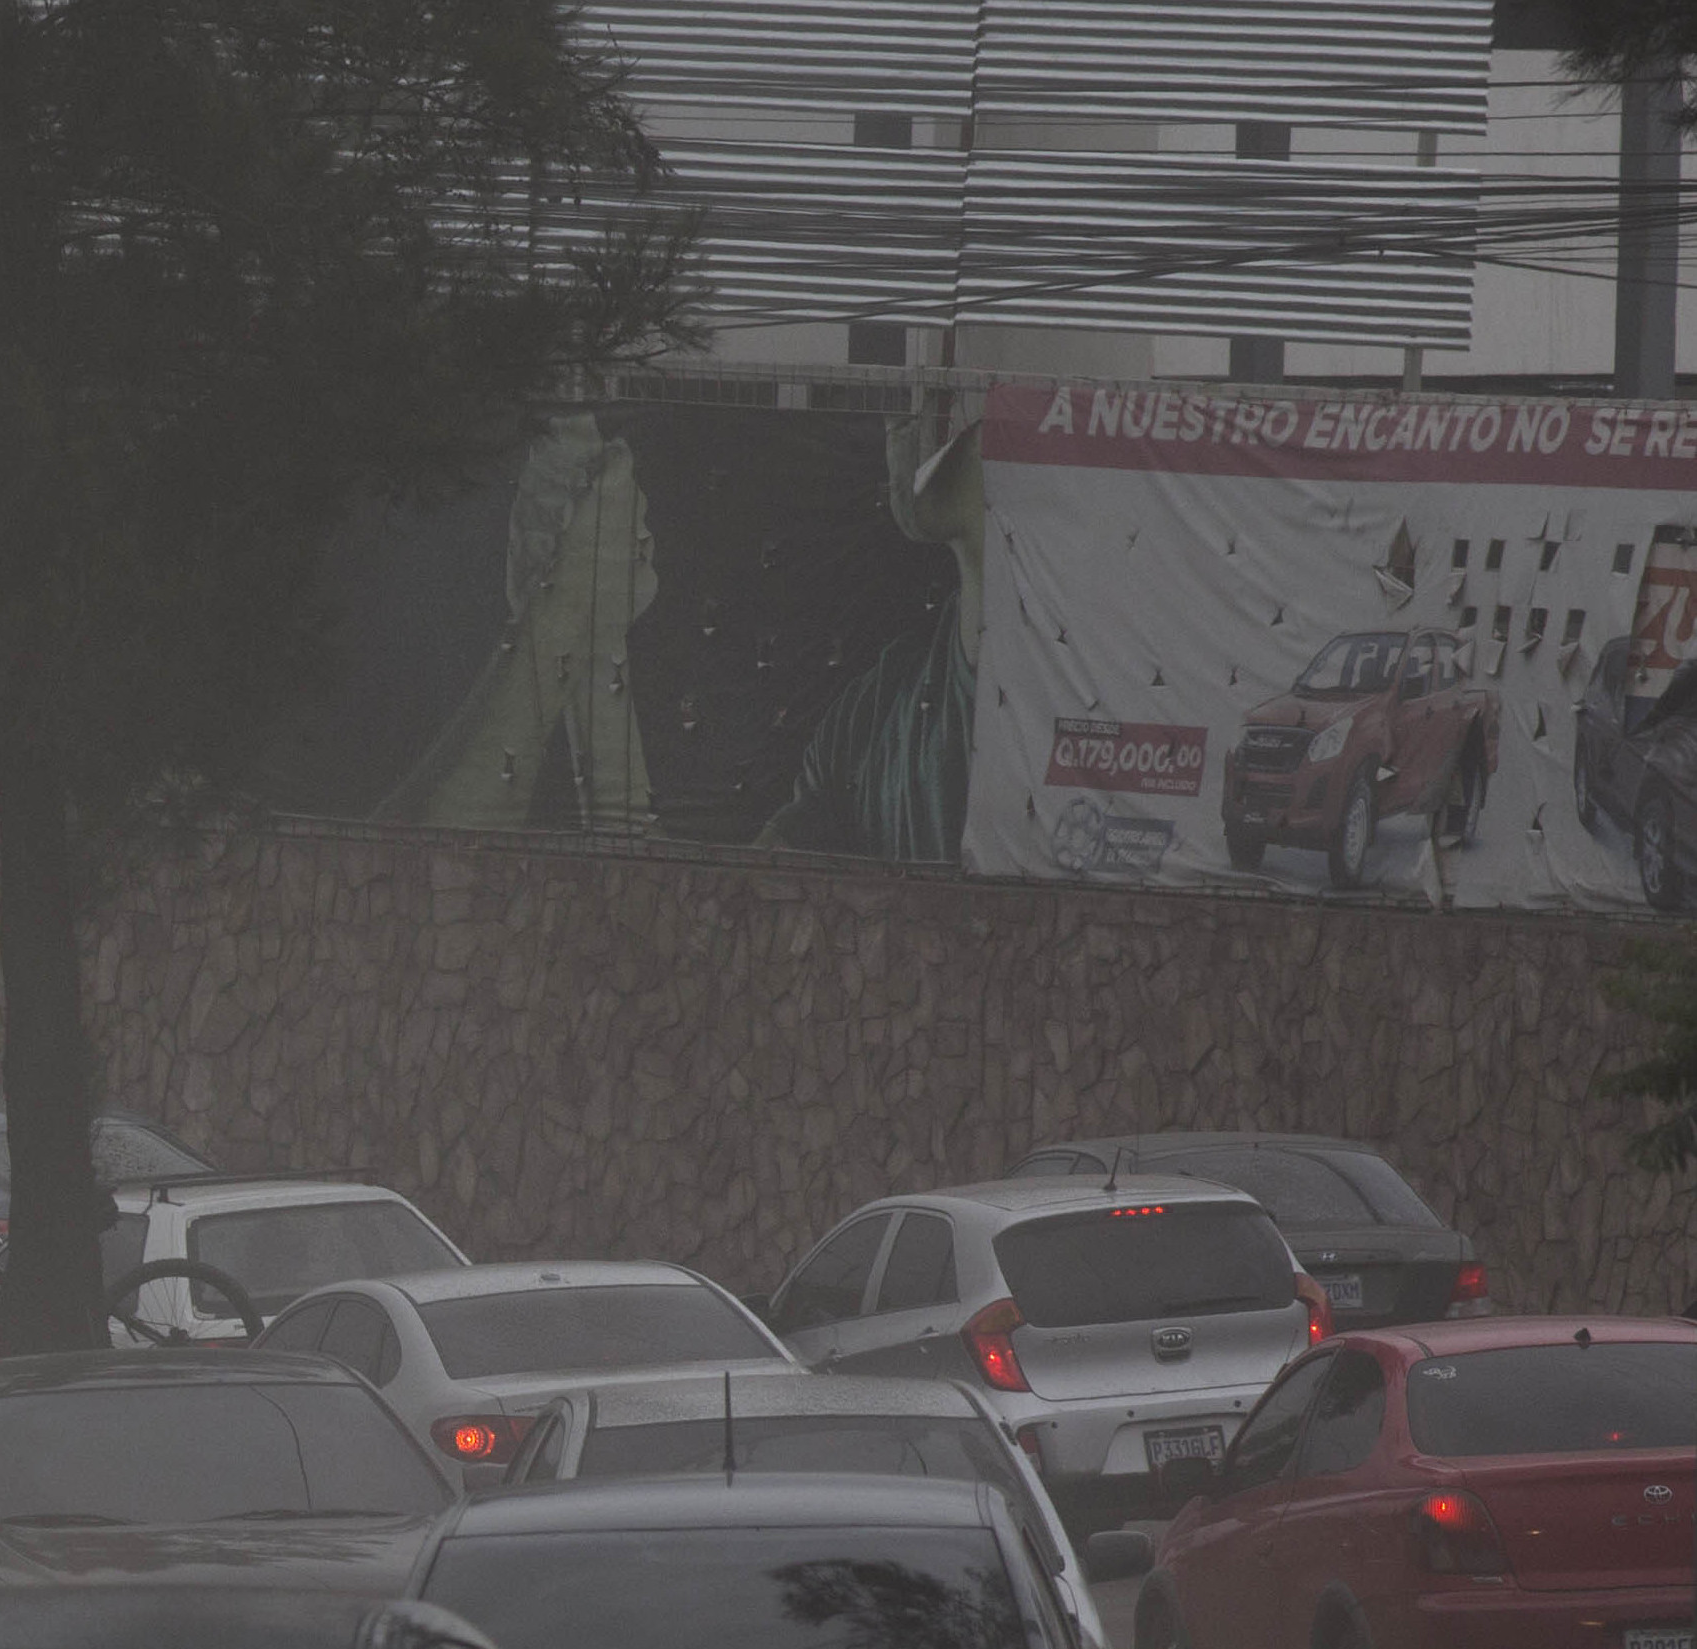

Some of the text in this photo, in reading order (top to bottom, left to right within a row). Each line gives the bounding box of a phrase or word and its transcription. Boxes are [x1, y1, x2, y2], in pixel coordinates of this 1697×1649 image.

[1039, 386, 1074, 436] A
[1087, 388, 1299, 447] NUESTRO
[1303, 403, 1502, 454] ENCANTO
[1506, 405, 1570, 455] NO
[1584, 407, 1637, 457] SE
